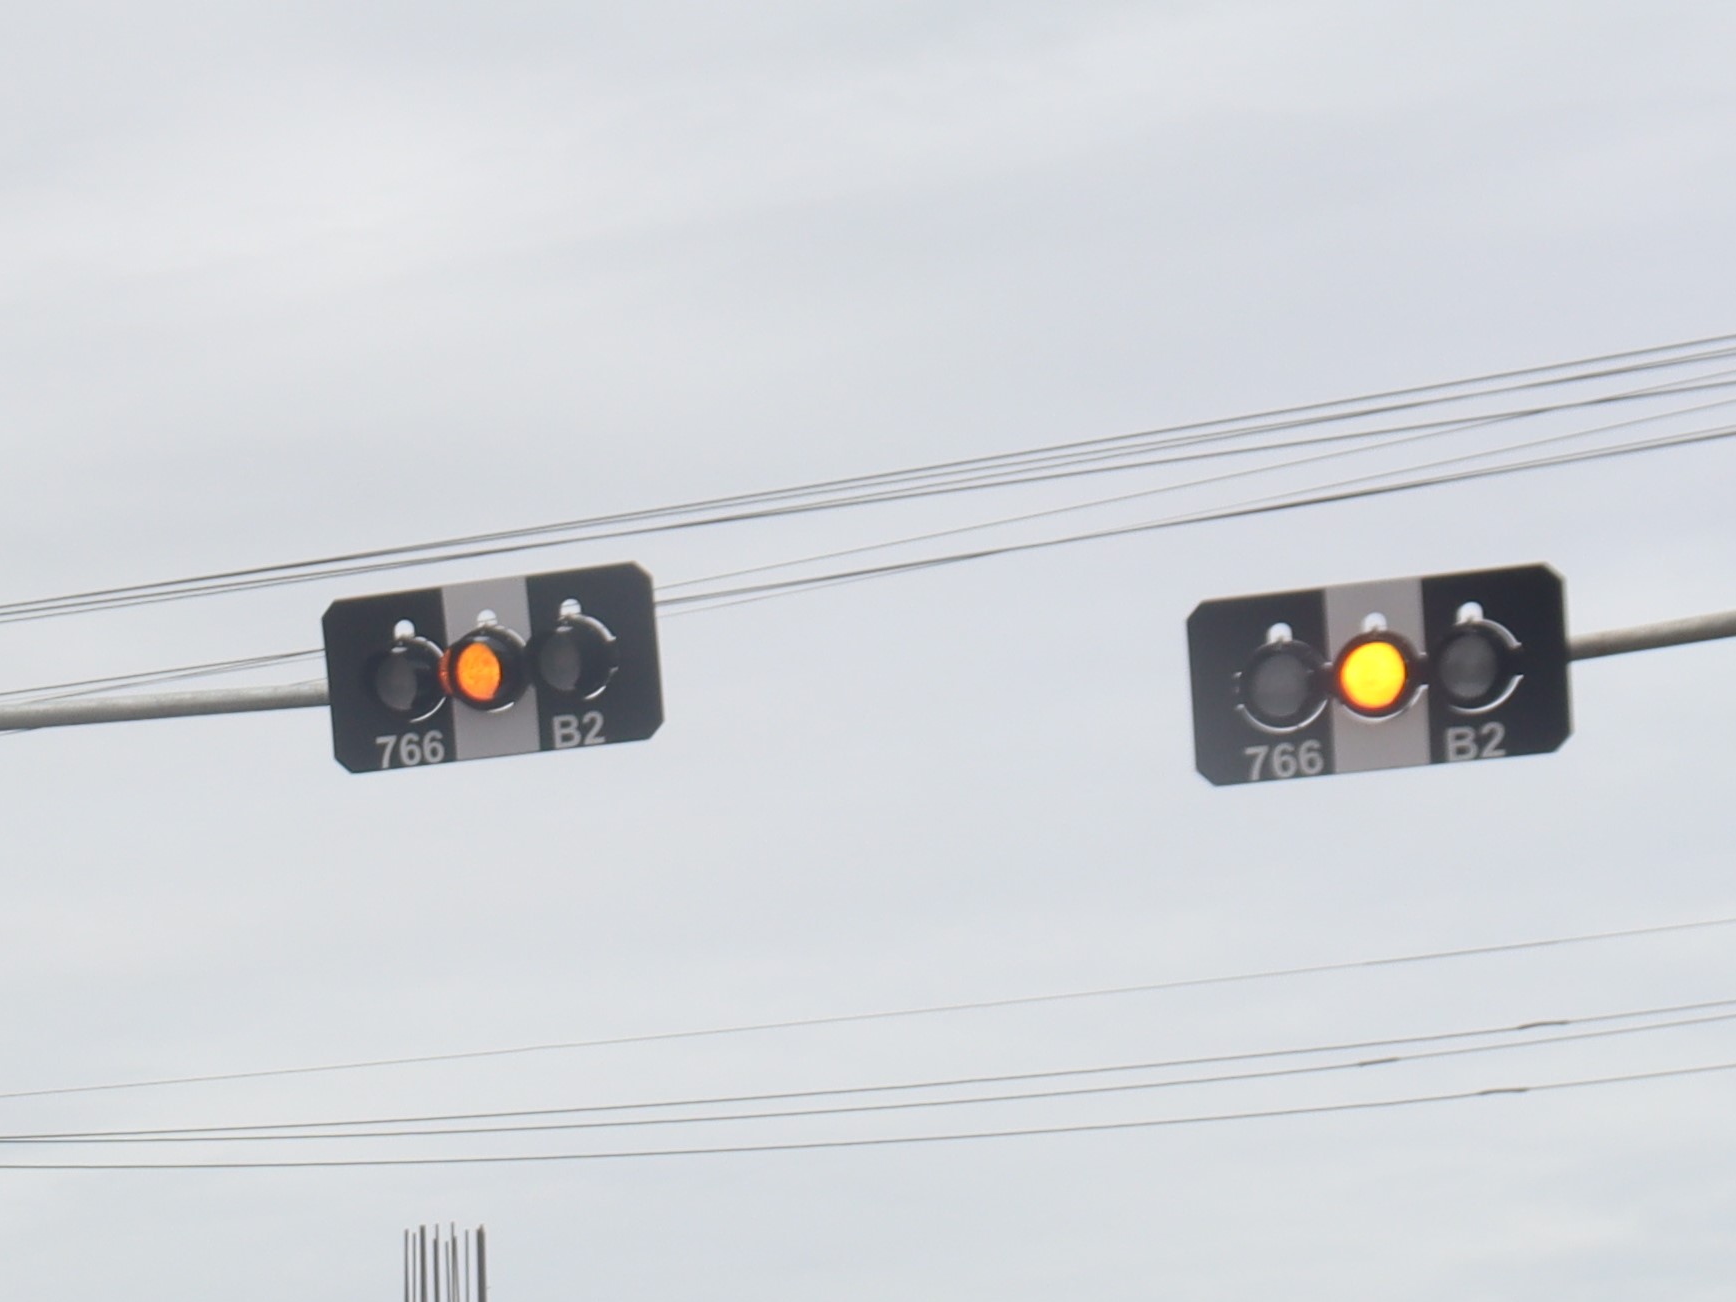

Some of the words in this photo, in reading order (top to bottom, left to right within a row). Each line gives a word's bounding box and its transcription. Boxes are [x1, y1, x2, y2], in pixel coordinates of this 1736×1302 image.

[375, 731, 445, 769] 766
[552, 711, 606, 749] B2
[1245, 739, 1324, 781] 766
[1445, 722, 1506, 762] B2
